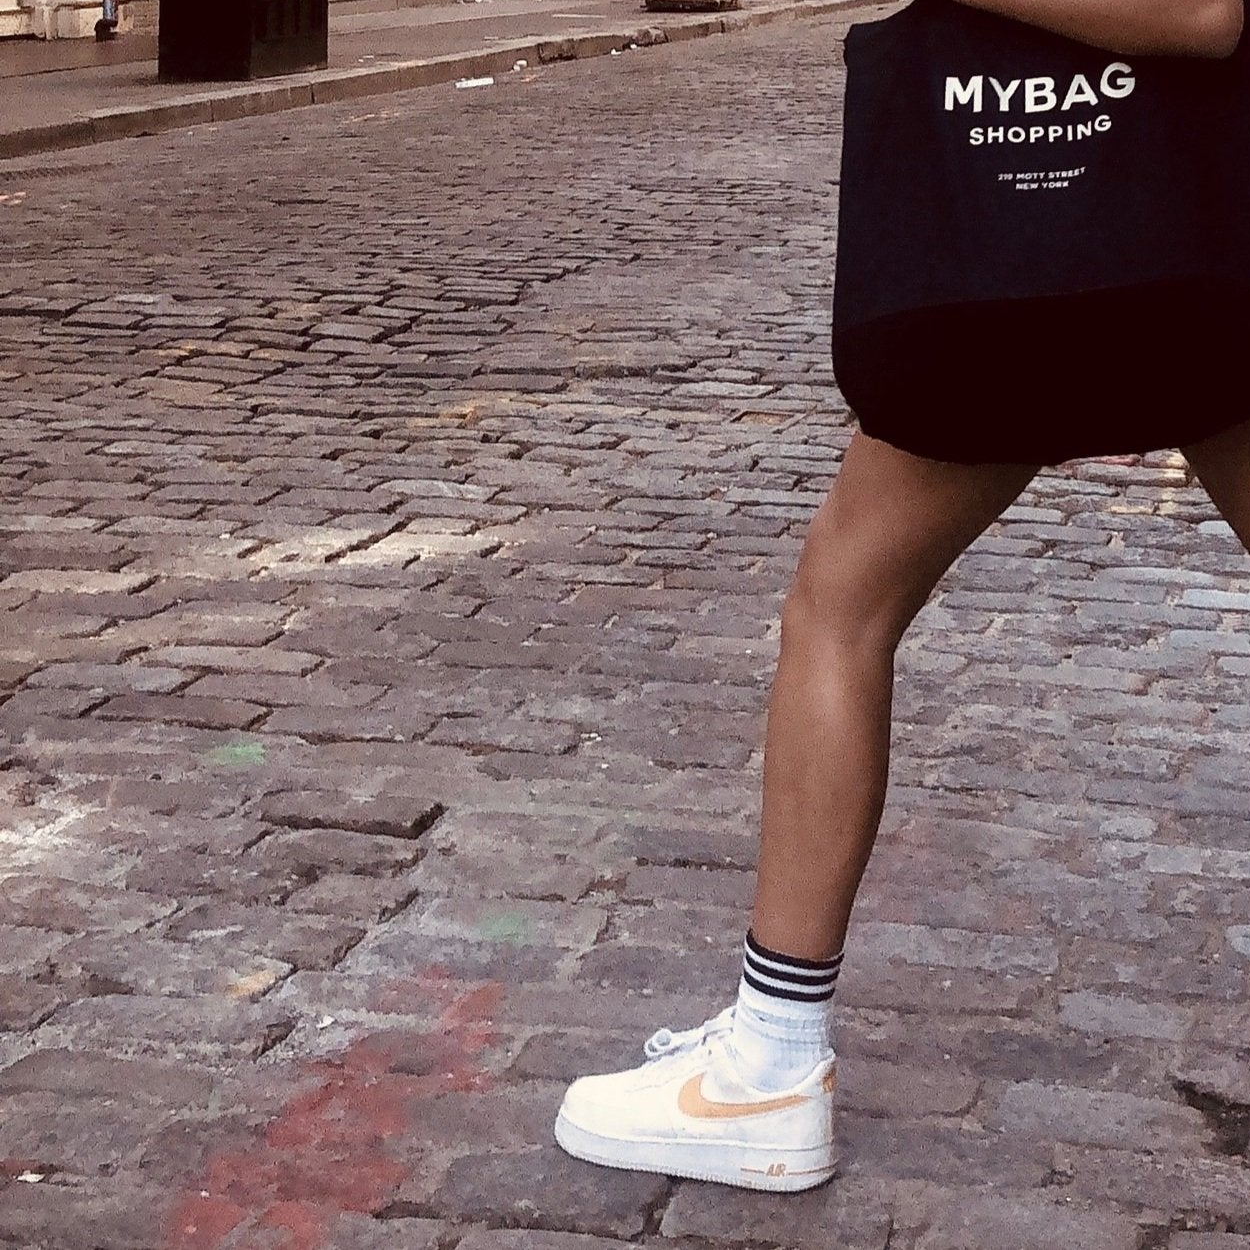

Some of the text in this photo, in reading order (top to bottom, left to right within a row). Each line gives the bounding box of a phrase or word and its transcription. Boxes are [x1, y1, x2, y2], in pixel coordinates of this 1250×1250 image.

[944, 62, 1136, 114] MYBAG
[969, 115, 1112, 145] SHOPPING
[1016, 172, 1045, 181] MOTT
[1048, 166, 1086, 179] STREET
[1016, 181, 1069, 190] NEW YORK
